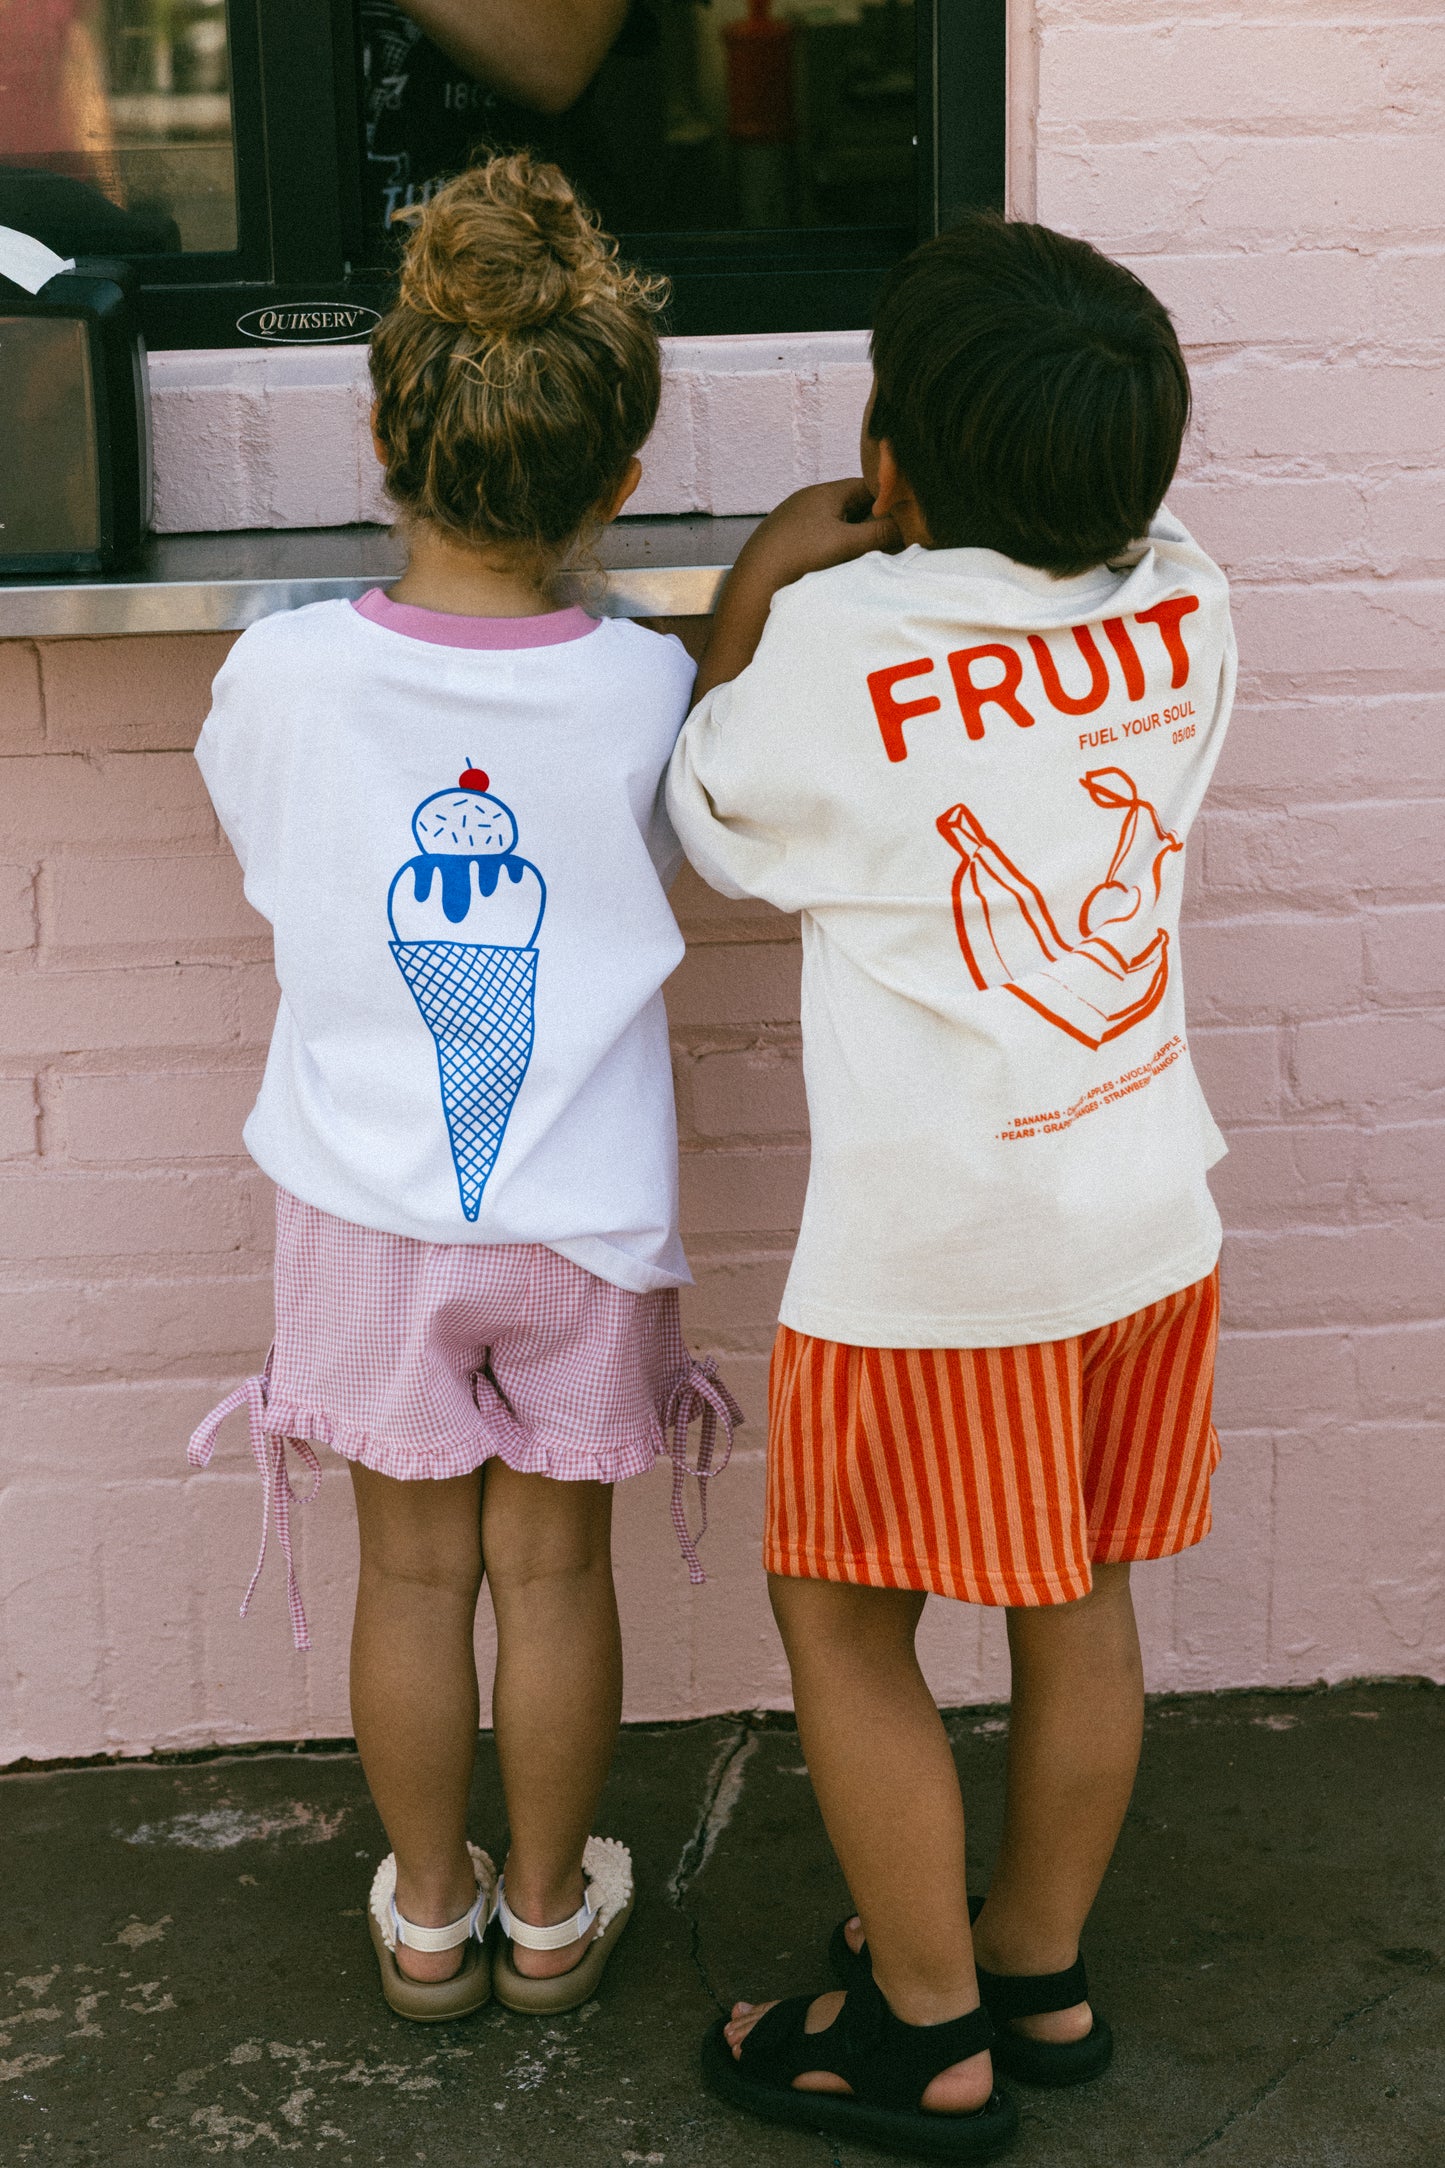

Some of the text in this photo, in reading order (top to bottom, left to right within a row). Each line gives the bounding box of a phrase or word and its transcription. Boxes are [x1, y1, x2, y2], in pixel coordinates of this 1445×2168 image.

[259, 311, 358, 335] QUIKSERV
[866, 595, 1200, 763] FRUIT
[1078, 701, 1196, 750] FUEL YOUR SOUL
[1172, 724, 1196, 745] 05/05
[1014, 1110, 1061, 1127] BANANAS
[1086, 1081, 1115, 1100] APPLES
[1001, 1129, 1035, 1141] PEARS
